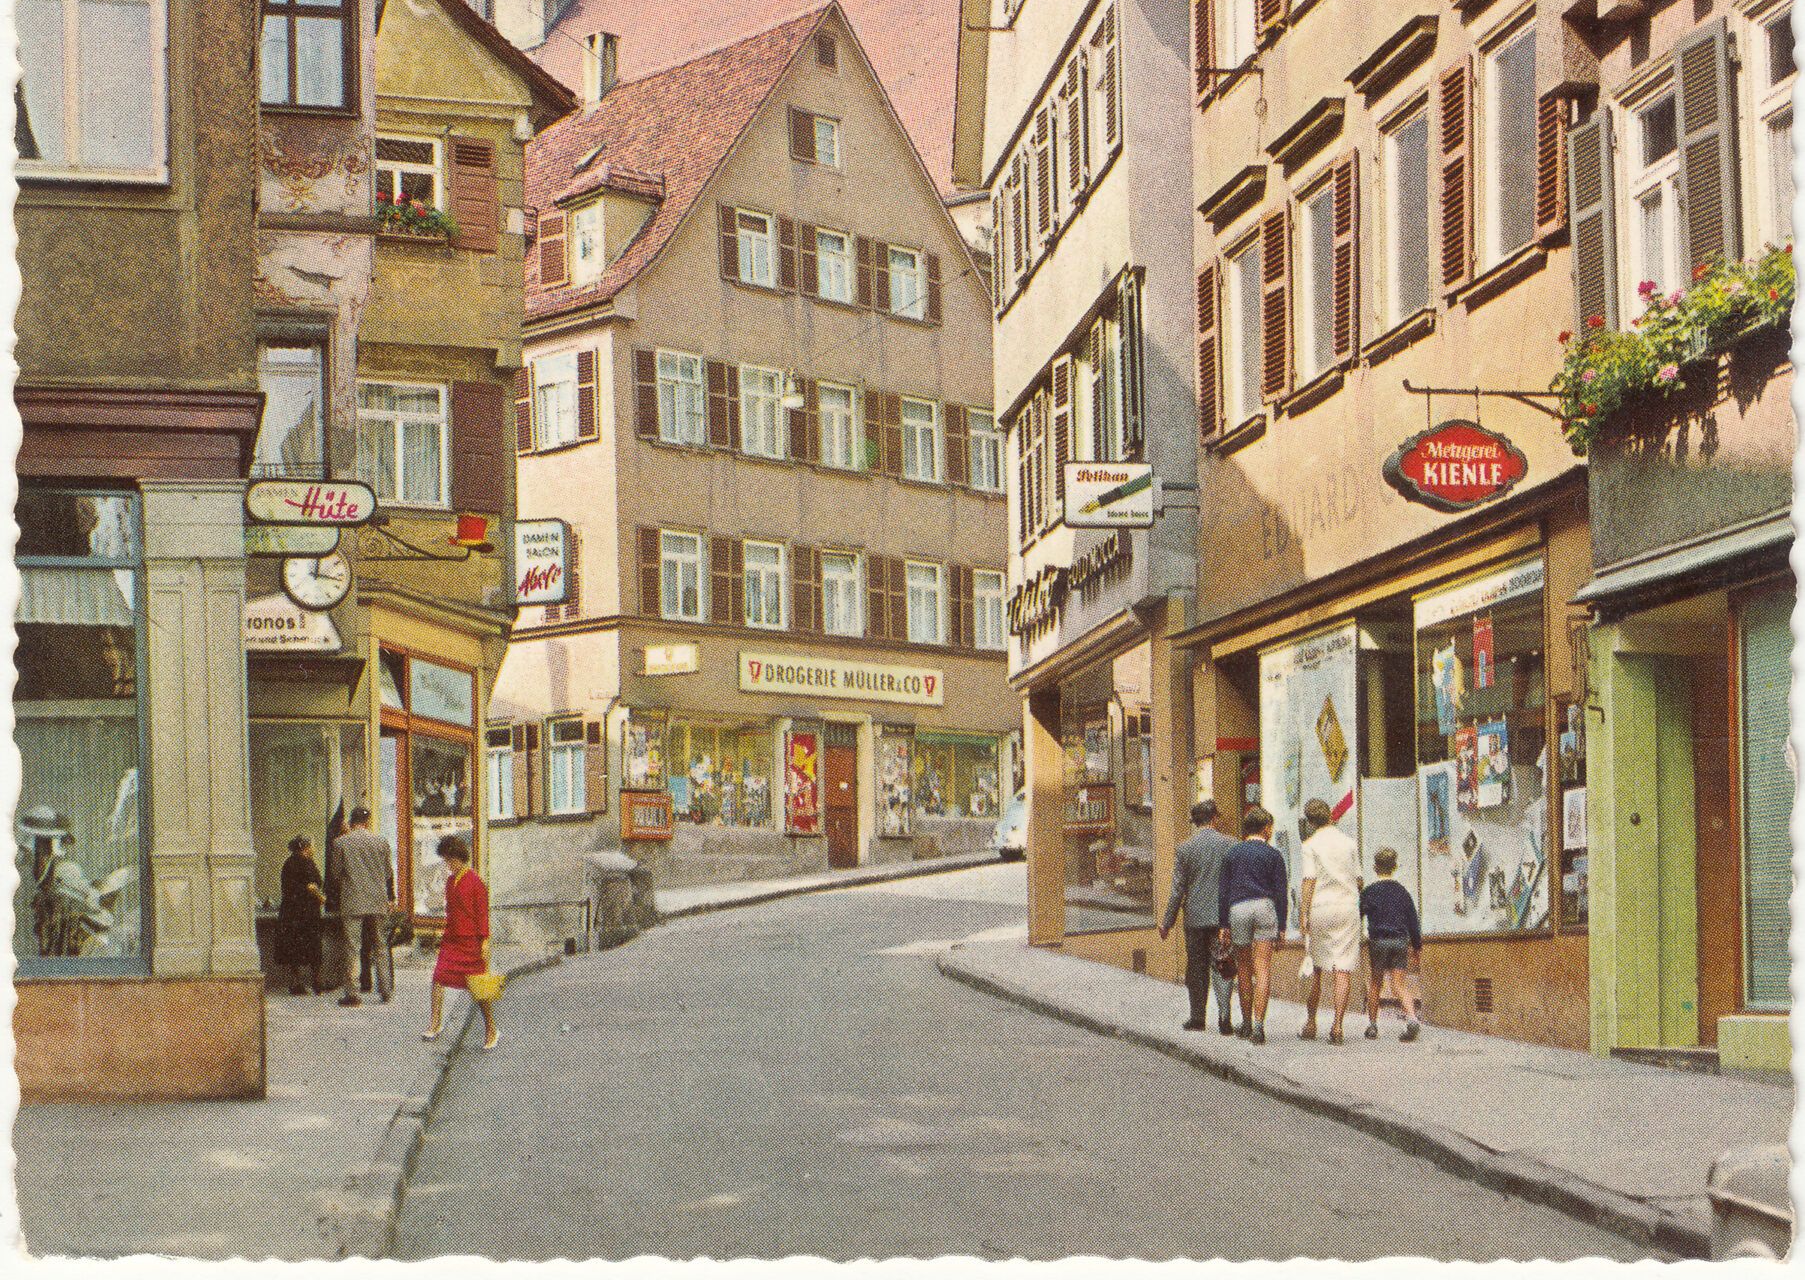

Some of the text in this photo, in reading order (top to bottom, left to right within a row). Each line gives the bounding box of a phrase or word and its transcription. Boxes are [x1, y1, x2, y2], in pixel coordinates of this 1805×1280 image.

[1421, 442, 1500, 462] Metzgerei
[1076, 469, 1129, 482] Pelikan
[1423, 462, 1503, 486] KIENLE
[284, 486, 359, 520] Hüte
[522, 532, 559, 545] DAMEN
[526, 547, 559, 559] SALON
[246, 616, 296, 630] ronos
[765, 663, 837, 688] DROGERIE
